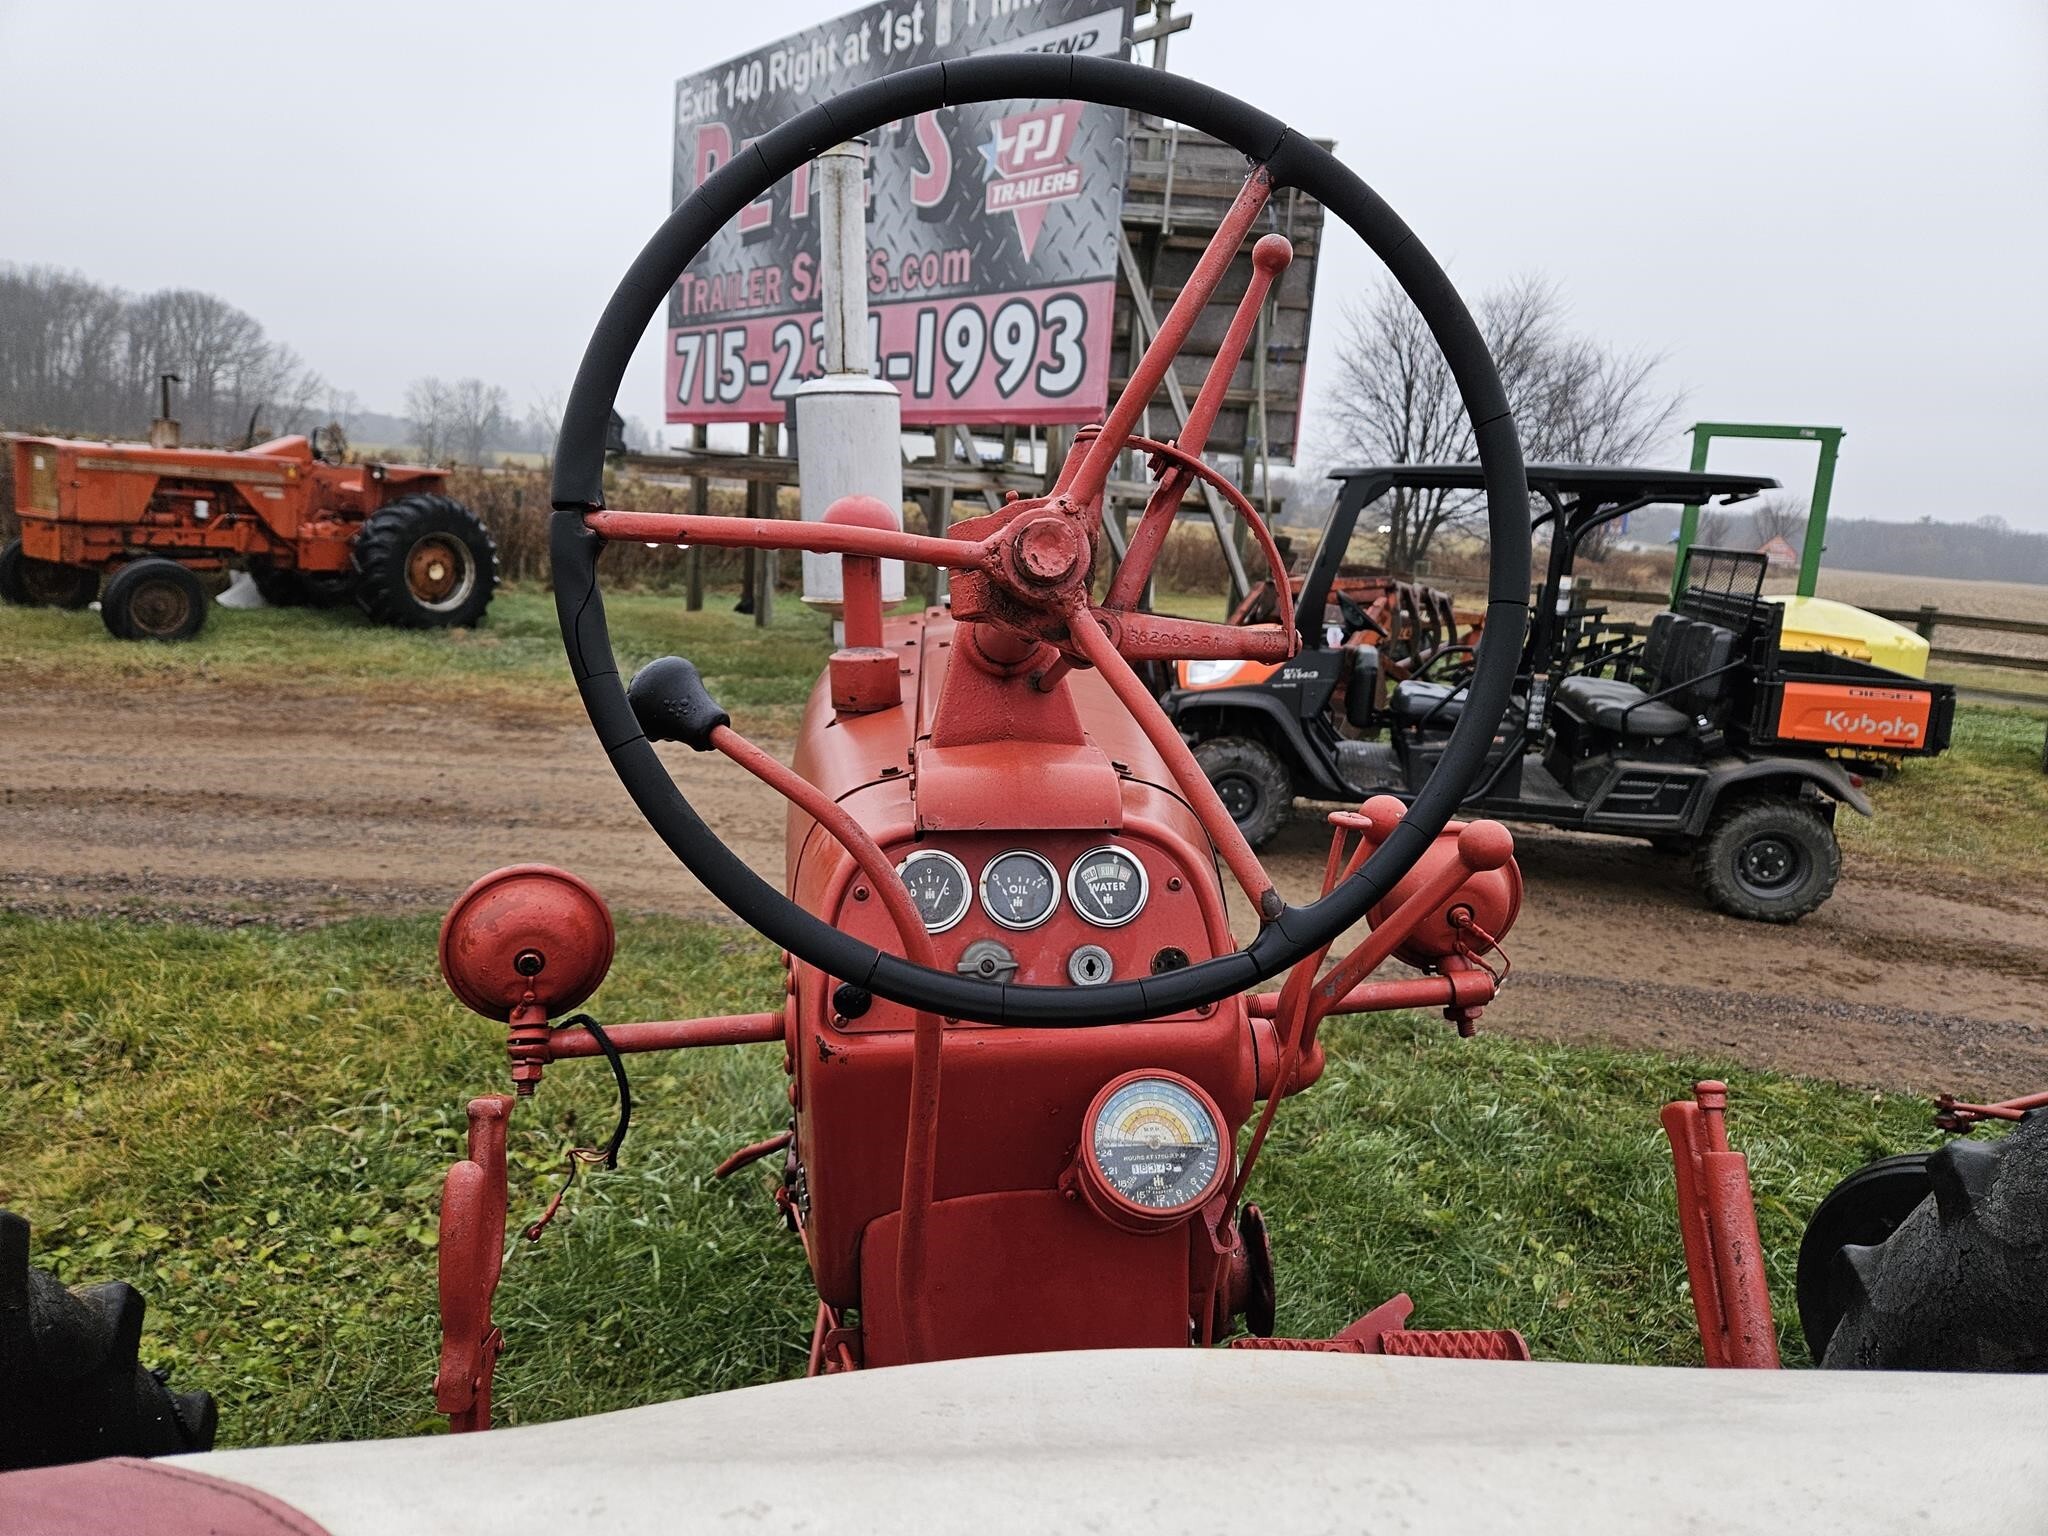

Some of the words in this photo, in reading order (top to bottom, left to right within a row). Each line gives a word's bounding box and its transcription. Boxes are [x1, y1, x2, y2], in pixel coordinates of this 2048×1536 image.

[679, 79, 720, 123] Exit
[724, 59, 764, 109] 140
[768, 34, 838, 94] Right
[843, 20, 871, 67] at
[879, 1, 924, 54] 1st
[1011, 113, 1066, 165] PJ
[992, 169, 1079, 205] TRAILERS
[790, 248, 972, 302] SS.com
[675, 292, 1088, 405] 715-2-1993
[1849, 688, 1921, 701] DIESEL
[1824, 710, 1920, 739] Kubota
[1036, 875, 1048, 886] 75
[943, 887, 950, 896] C
[1009, 885, 1028, 895] OIL
[1089, 882, 1126, 892] WATER
[910, 888, 917, 897] D
[1100, 1149, 1112, 1158] 24
[1107, 1167, 1118, 1175] 21
[1136, 1190, 1146, 1199] 15
[1156, 1194, 1165, 1202] 12
[1175, 1189, 1183, 1197] 9
